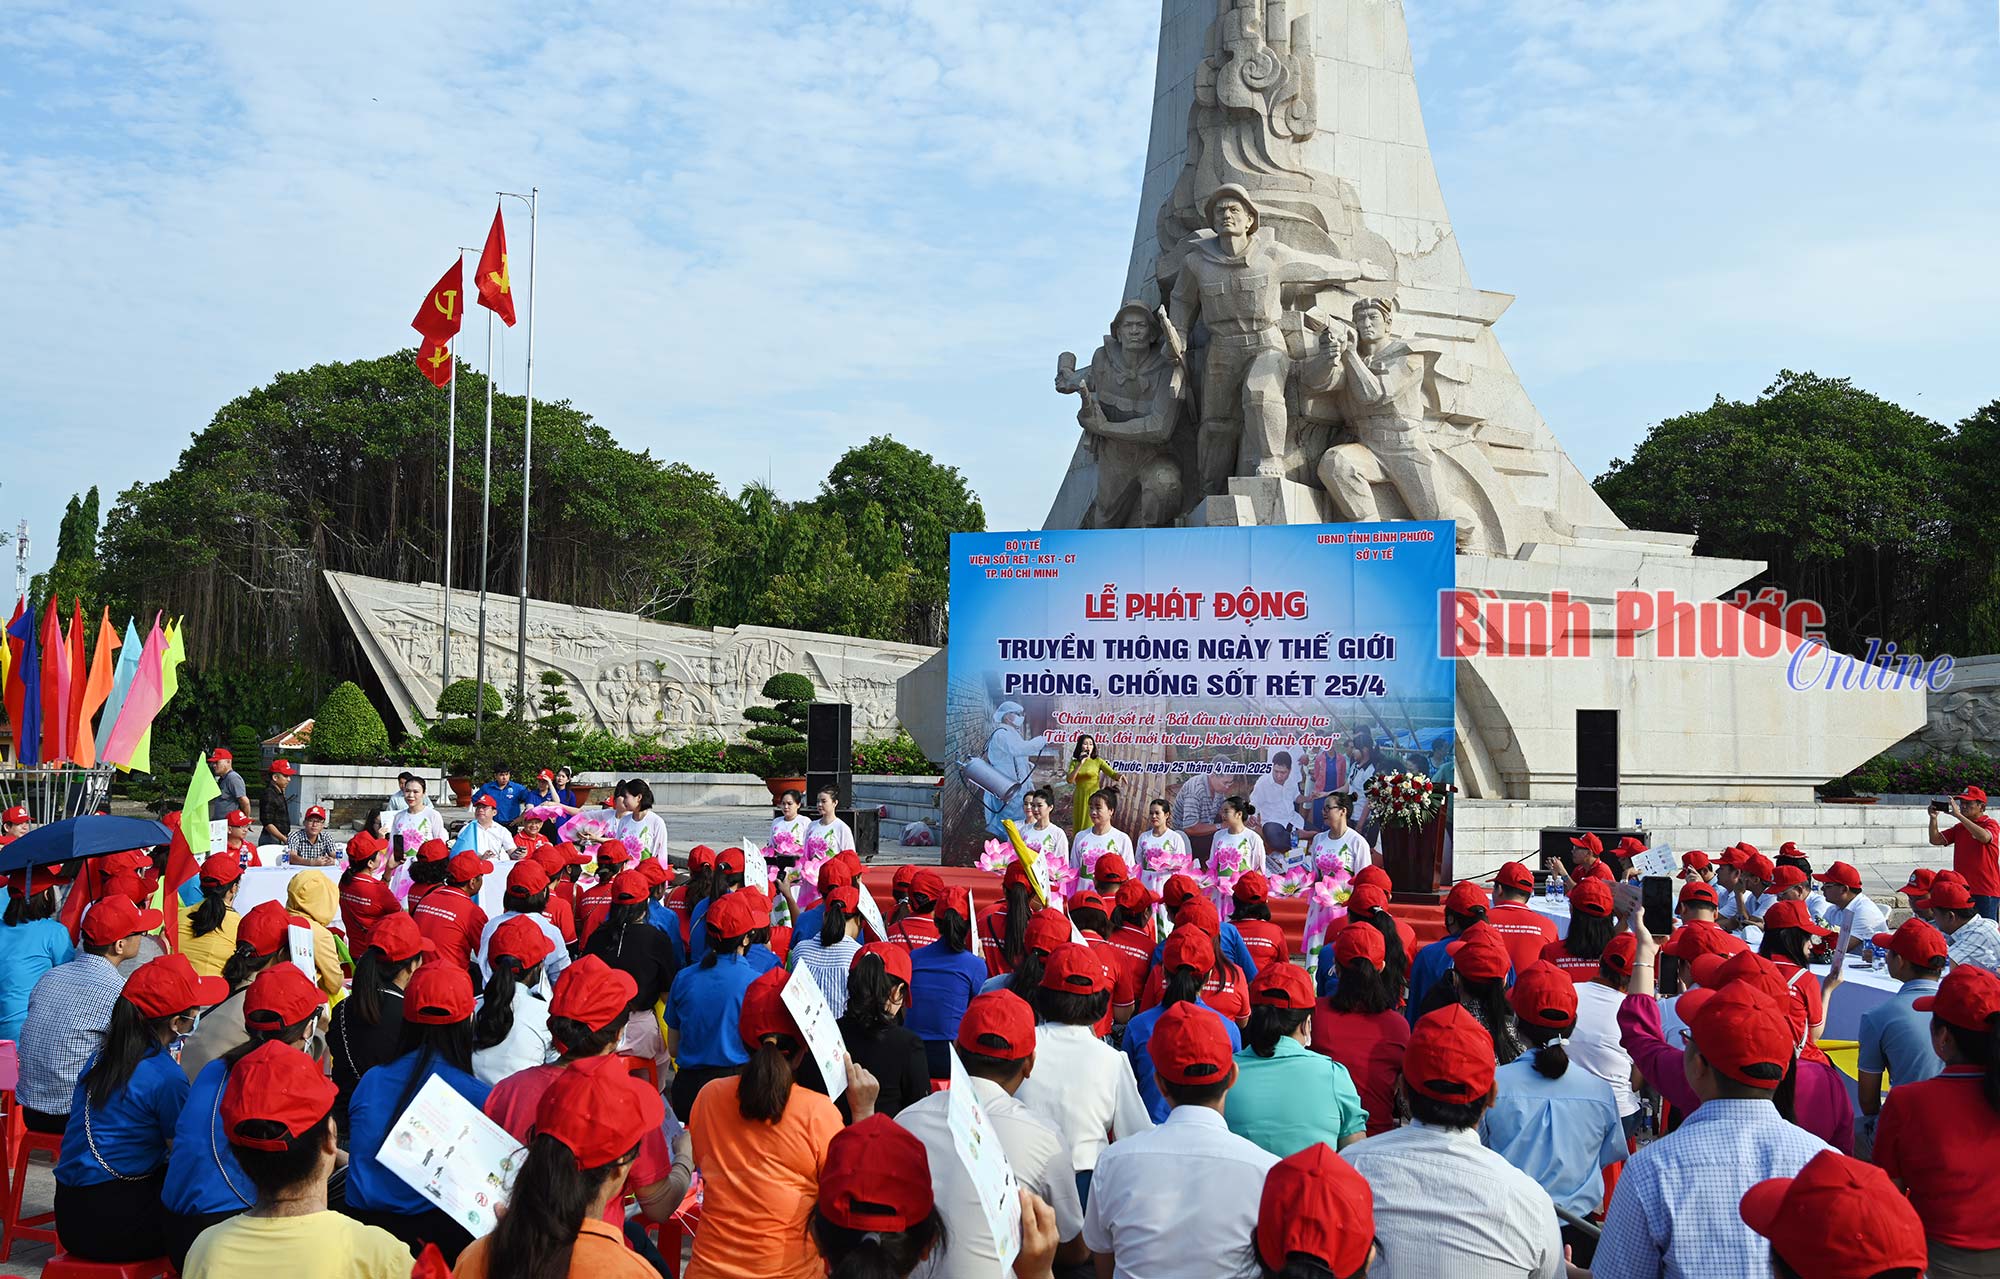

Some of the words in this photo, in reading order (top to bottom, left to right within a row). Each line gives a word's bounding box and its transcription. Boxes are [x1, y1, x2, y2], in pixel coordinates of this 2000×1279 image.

[1005, 539, 1019, 551] BỘ
[1021, 541, 1027, 550] Y
[1029, 538, 1041, 550] TẾ
[1317, 534, 1345, 544] UBND
[1347, 530, 1370, 543] TỈNH
[1372, 531, 1397, 542] BÌNH
[1400, 530, 1434, 541] PHƯỚC
[969, 554, 990, 567] VIỆN
[993, 552, 1010, 564] SỐT
[1012, 553, 1029, 564] RÉT
[1038, 554, 1056, 564] KST
[1064, 554, 1076, 564] CT
[1356, 548, 1370, 560] SỞ
[1372, 550, 1378, 559] Y
[1381, 546, 1394, 559] TẾ
[985, 569, 998, 578] TP.
[1015, 567, 1031, 578] CHÍ
[1033, 568, 1059, 578] MINH
[1085, 583, 1118, 621] LỄ
[1125, 587, 1205, 621] PHÁT
[1213, 586, 1308, 626] ĐỘNG
[998, 632, 1096, 660] TRUYỀN
[1103, 635, 1190, 660] THÔNG
[1198, 635, 1271, 660] NGÀY
[1278, 631, 1333, 660] THẾ
[1338, 632, 1396, 660] GIỚI
[1005, 668, 1100, 697] PHÒNG,
[1108, 667, 1199, 696] CHỐNG
[1207, 667, 1258, 697] SỐT
[1266, 670, 1317, 697] RÉT
[1324, 674, 1386, 697] 25/4
[1095, 712, 1115, 725] dứt
[1117, 711, 1136, 725] sốt
[1139, 713, 1155, 725] rét
[1166, 711, 1189, 726] Bắt
[1192, 711, 1217, 726] đầu
[1219, 712, 1233, 726] từ
[1234, 712, 1268, 726] chính
[1270, 713, 1309, 729] chúng
[1311, 715, 1329, 727] ta:
[1044, 730, 1066, 743] Tái
[1068, 730, 1084, 743] đầ
[1135, 732, 1158, 744] mới
[1161, 732, 1175, 744] tư
[1235, 733, 1261, 749] dậy
[1262, 733, 1297, 746] hành
[1113, 760, 1144, 773] Phước,
[1146, 761, 1170, 774] ngày
[1171, 762, 1184, 773] 25
[1186, 761, 1213, 774] tháng
[1214, 763, 1222, 773] 4
[1223, 762, 1248, 774] năm
[1247, 763, 1273, 774] 2025
